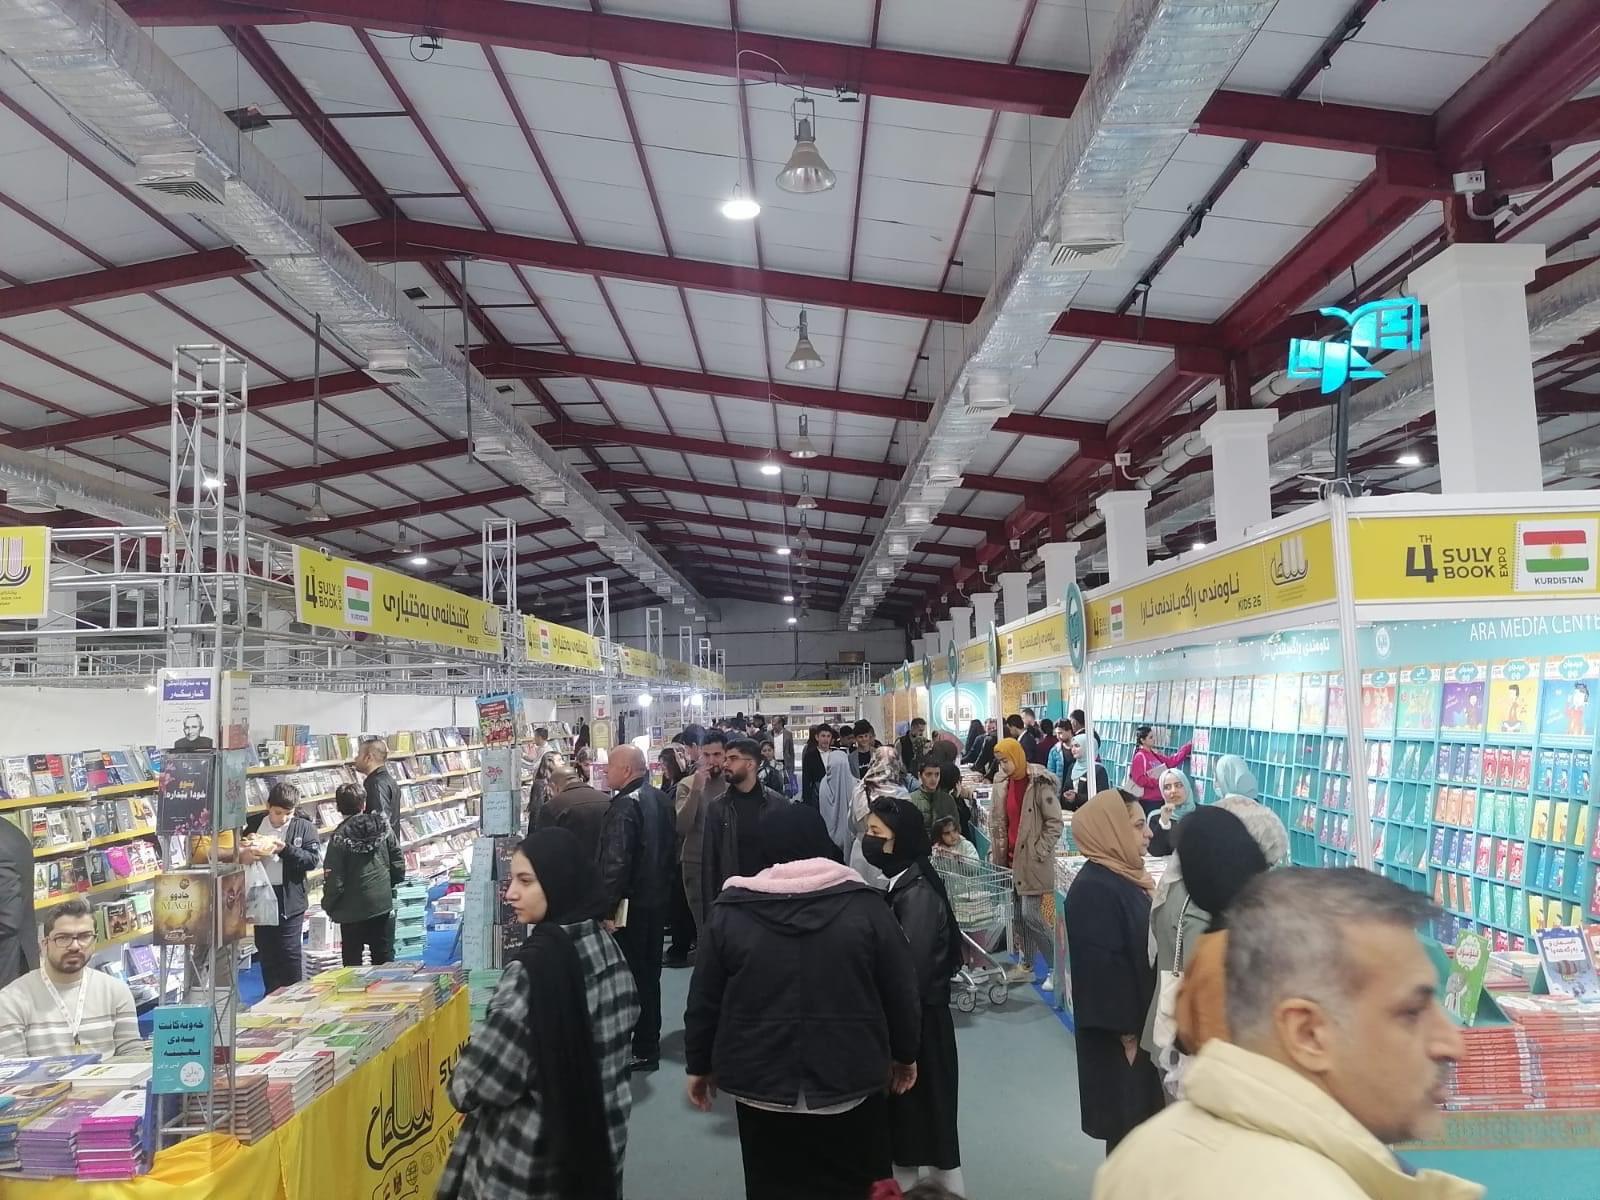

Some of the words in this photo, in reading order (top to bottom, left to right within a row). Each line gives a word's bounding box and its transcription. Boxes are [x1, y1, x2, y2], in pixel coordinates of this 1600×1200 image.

[1418, 534, 1433, 544] TH
[1405, 544, 1438, 583] 4
[1442, 547, 1493, 564] SULY
[1498, 546, 1509, 577] EXPO
[1443, 565, 1496, 580] BOOK
[1534, 576, 1584, 585] KURDISTAN
[305, 574, 318, 609] 4
[318, 580, 337, 596] SULY
[318, 596, 338, 611] BOOK
[1470, 621, 1498, 641] ARA
[1500, 615, 1549, 640] MEDIA
